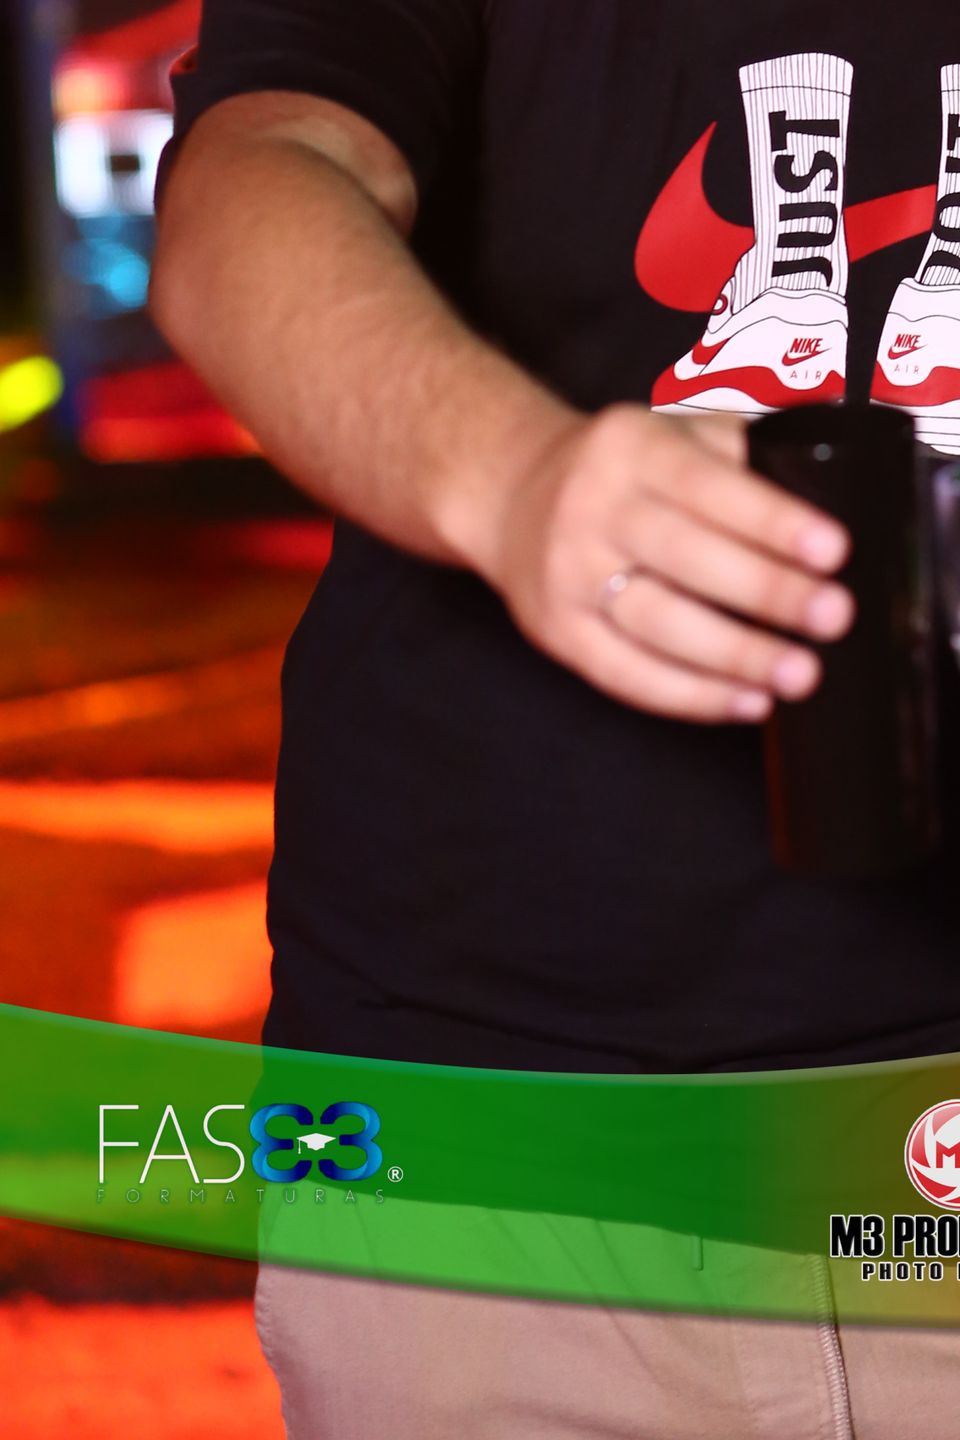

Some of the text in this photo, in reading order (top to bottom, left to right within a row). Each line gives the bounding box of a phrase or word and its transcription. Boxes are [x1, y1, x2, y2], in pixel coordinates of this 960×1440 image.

[769, 110, 840, 287] JUST
[790, 338, 823, 353] NIKE
[894, 333, 921, 348] NIKE
[790, 370, 822, 380] AIR
[894, 364, 919, 374] AIR
